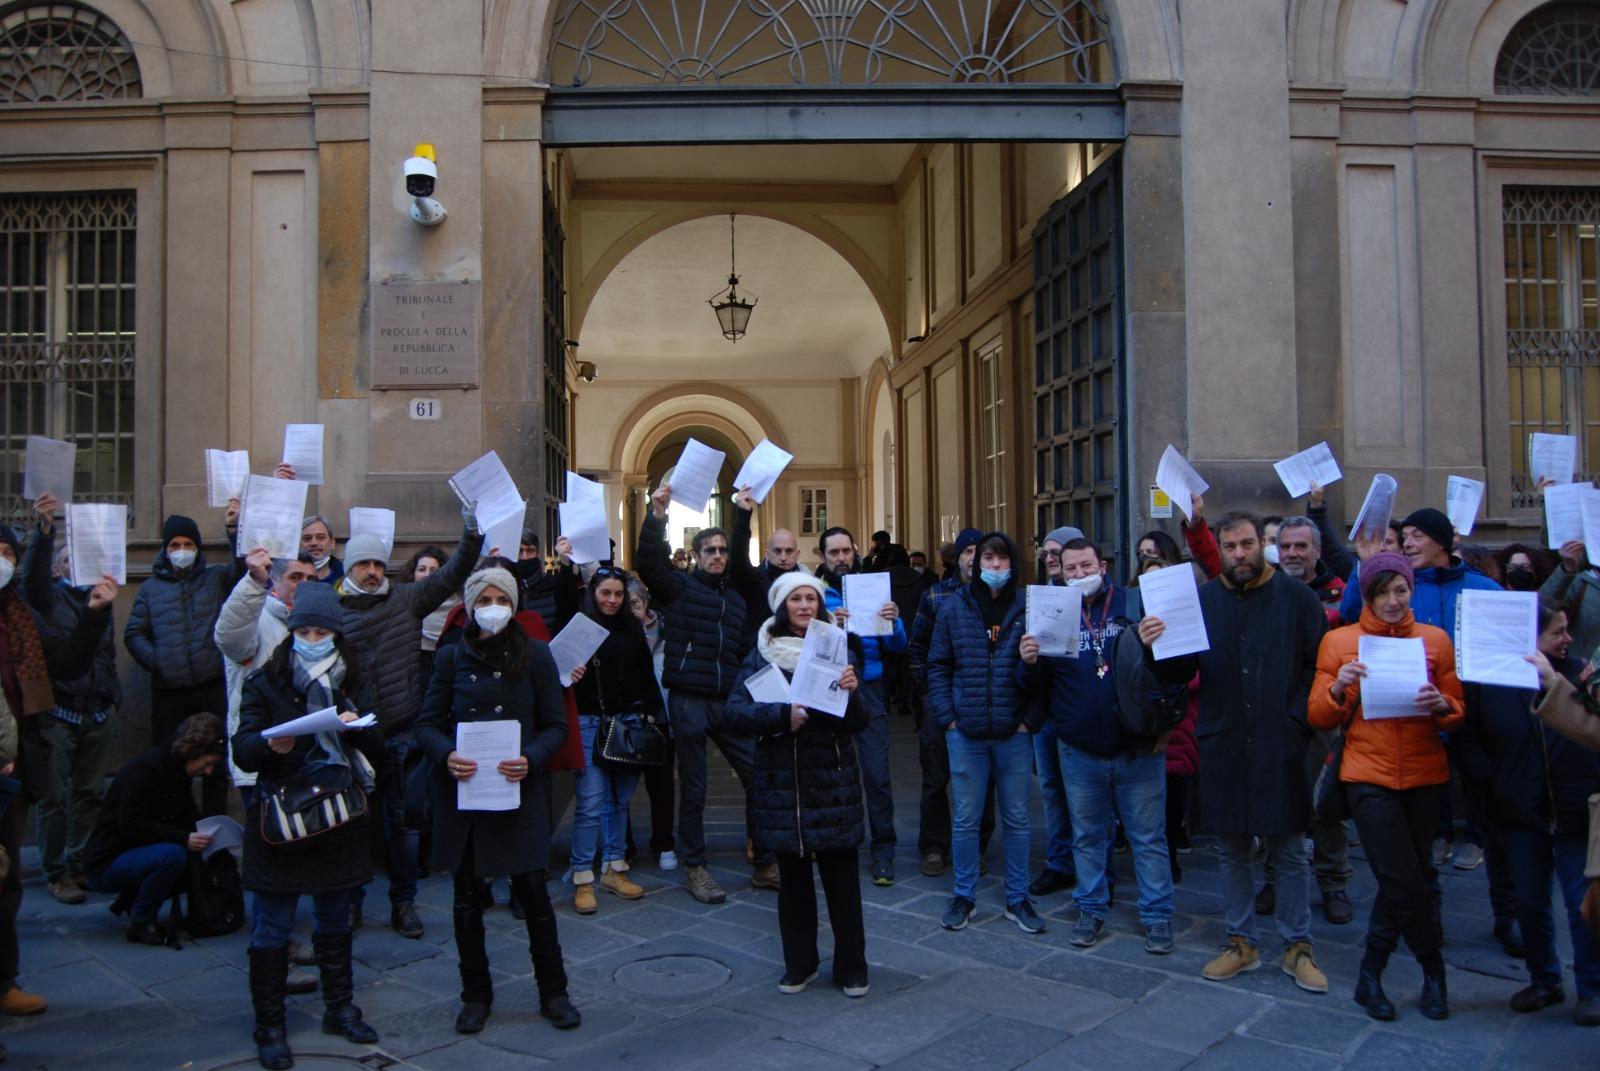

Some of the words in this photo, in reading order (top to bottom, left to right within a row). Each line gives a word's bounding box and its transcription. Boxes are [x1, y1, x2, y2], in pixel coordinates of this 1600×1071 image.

[394, 295, 454, 305] TRIBUNALE
[421, 311, 428, 320] E
[380, 327, 429, 337] PROCURA
[436, 327, 468, 336] DELLA
[393, 343, 455, 353] REPUBBLICA
[399, 366, 409, 375] DI
[415, 366, 448, 375] LUCCA
[416, 401, 433, 417] 61
